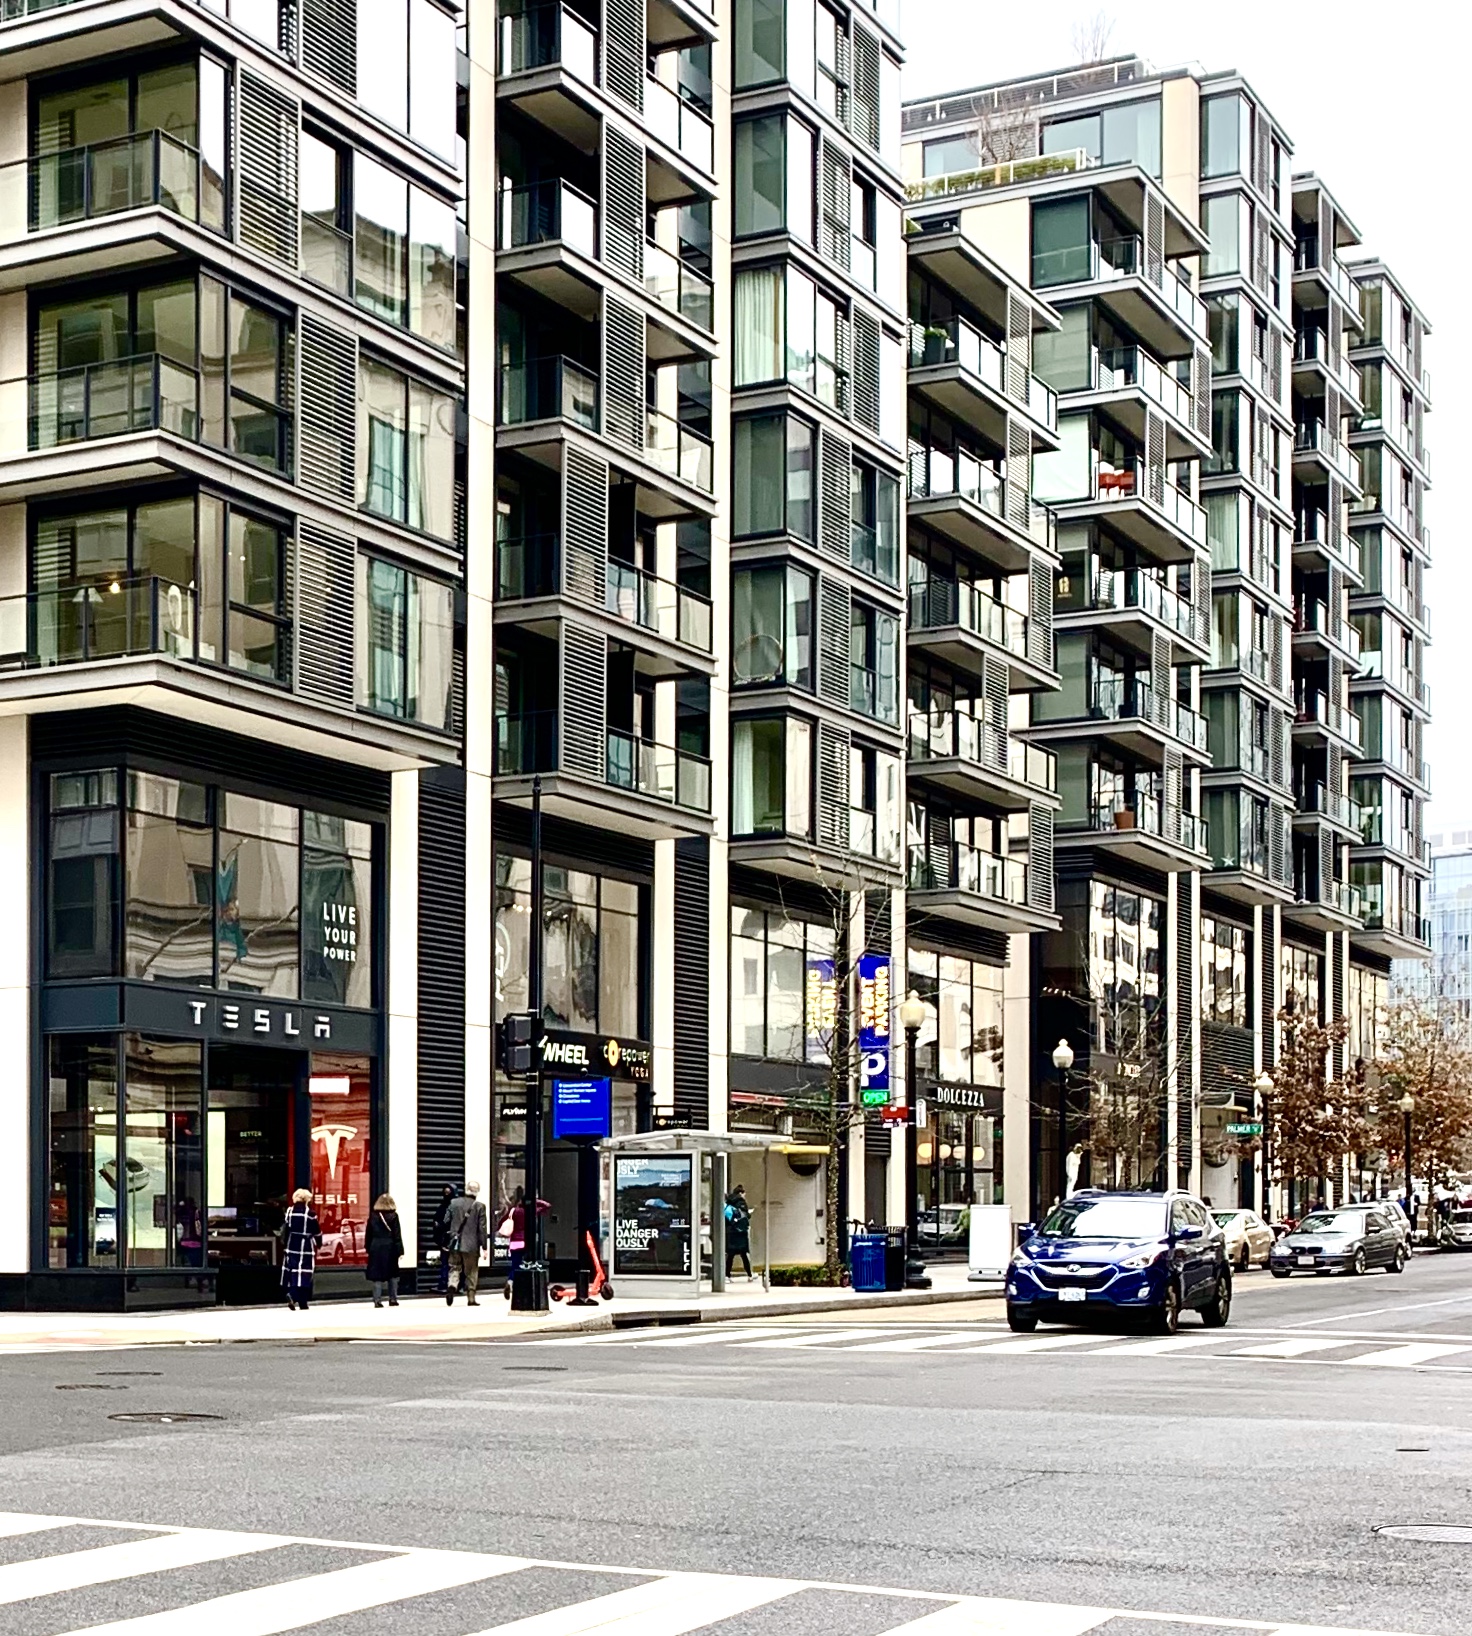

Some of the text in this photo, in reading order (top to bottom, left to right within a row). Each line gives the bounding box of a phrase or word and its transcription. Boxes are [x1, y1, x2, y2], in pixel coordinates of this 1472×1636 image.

[323, 901, 356, 925] LIVE
[324, 926, 356, 945] YOUR
[323, 946, 356, 962] POWER
[188, 1000, 331, 1039] TESLA
[860, 1052, 886, 1087] P
[937, 1086, 985, 1108] DOLCEZZA
[314, 1194, 358, 1204] ESLA
[616, 1219, 639, 1229] LIVE
[616, 1229, 660, 1239] DANGER
[616, 1238, 650, 1248] OUSLY
